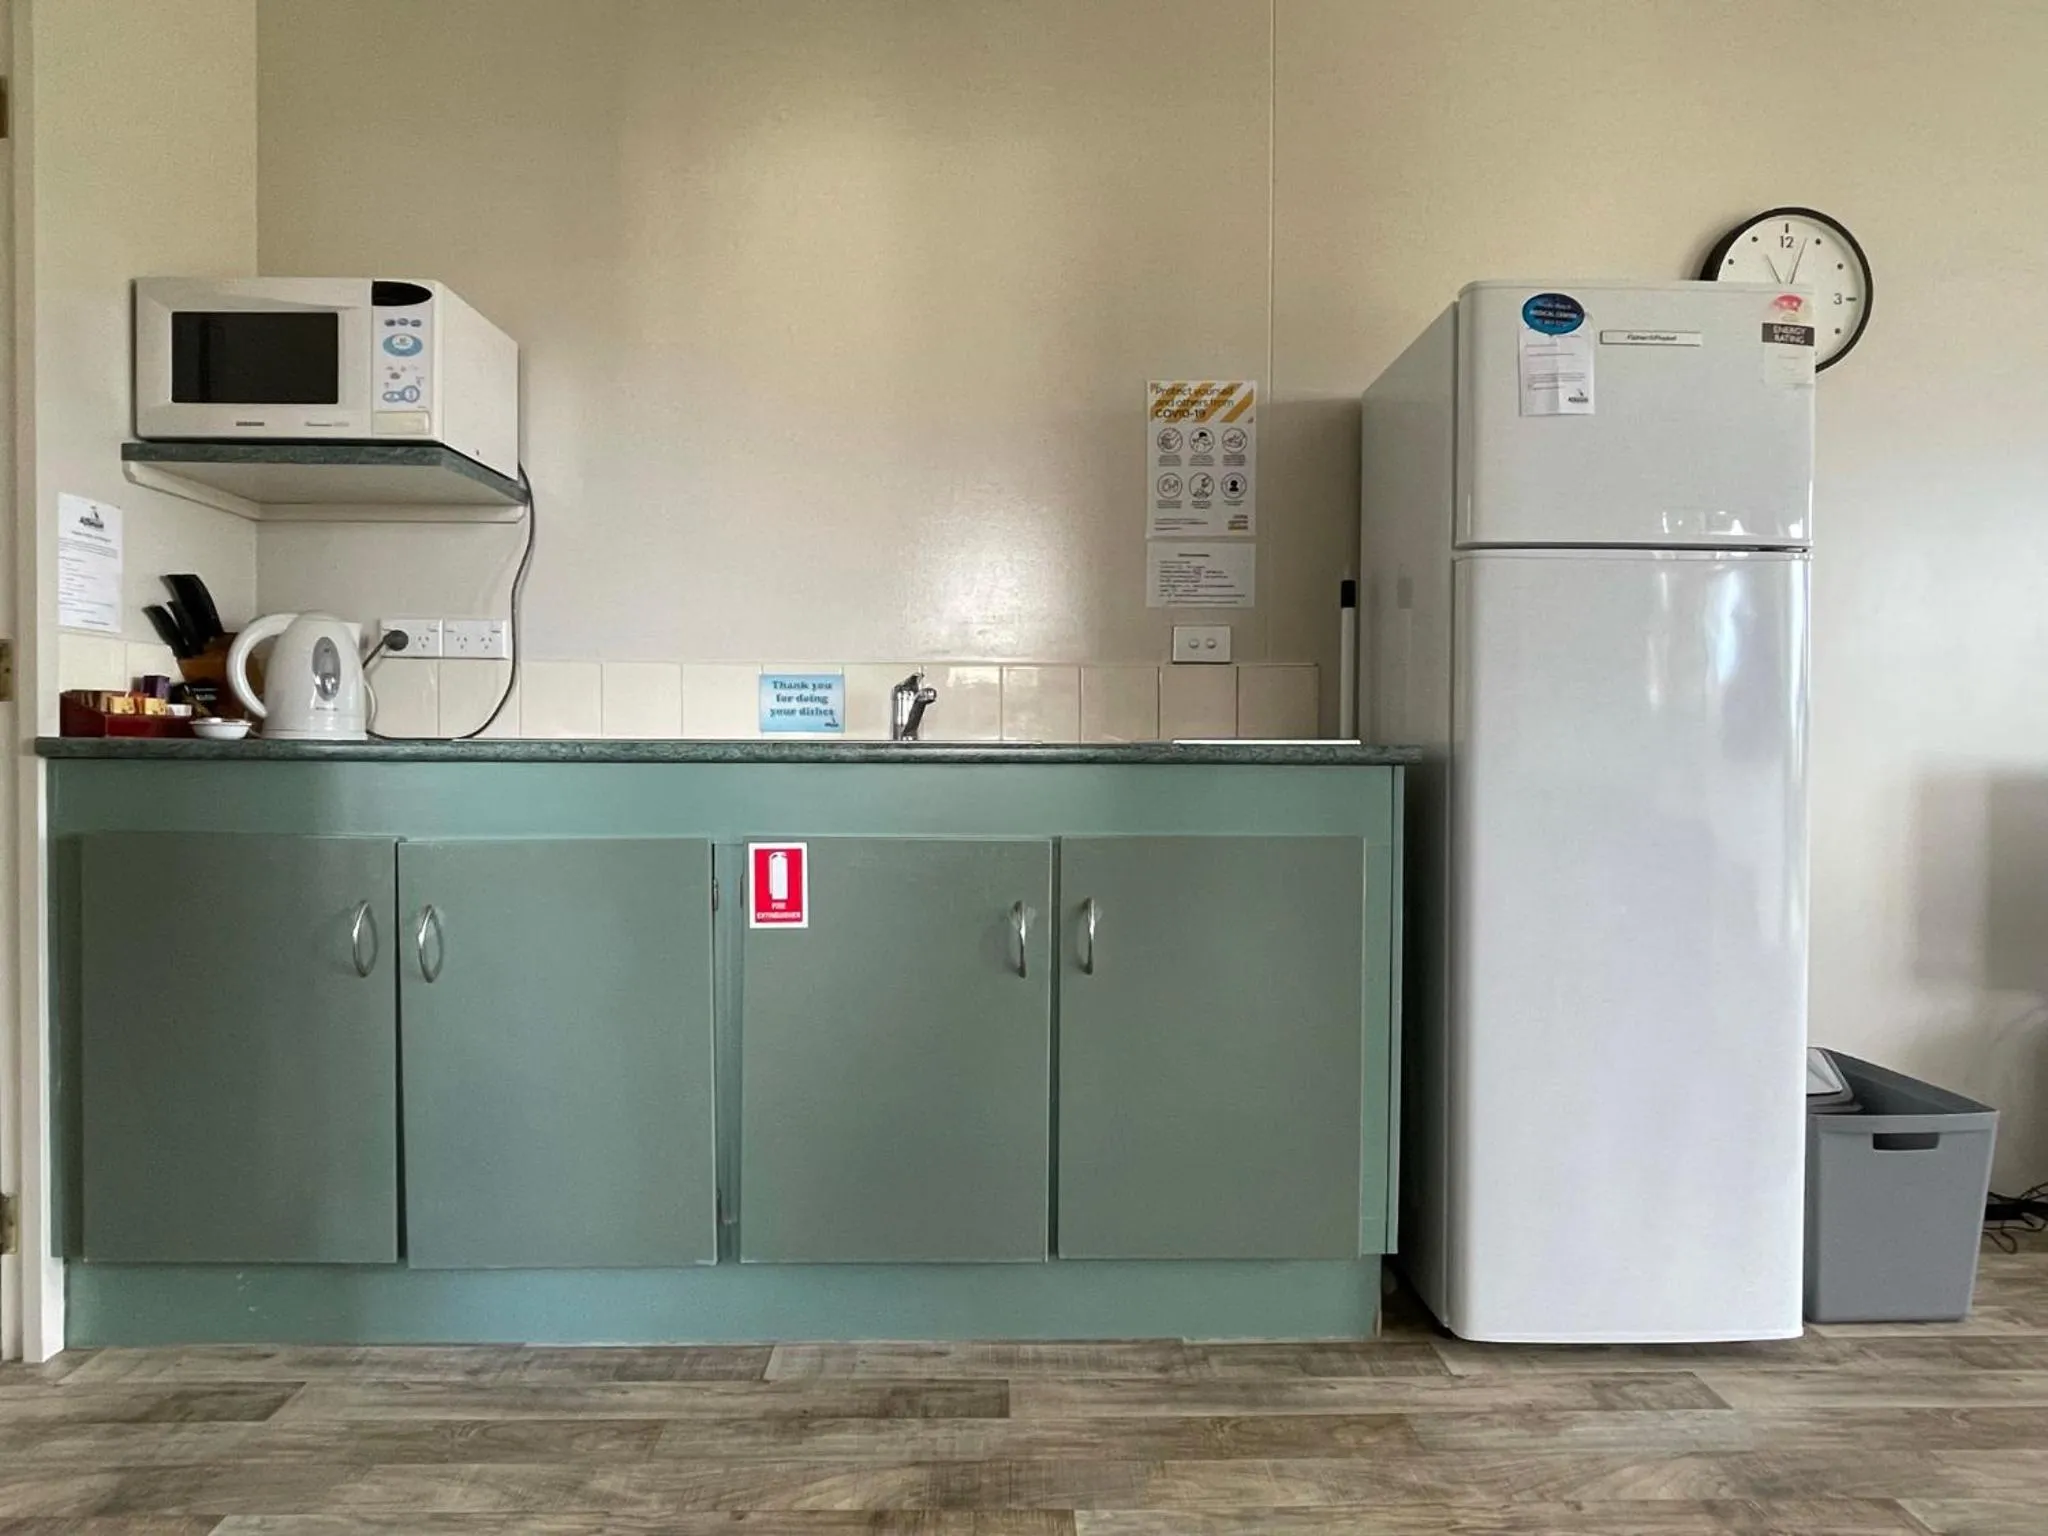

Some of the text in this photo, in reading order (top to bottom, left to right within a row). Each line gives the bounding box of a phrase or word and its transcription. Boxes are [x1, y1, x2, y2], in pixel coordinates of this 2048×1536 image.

[1779, 235, 1794, 249] 12
[1833, 292, 1843, 306] 3
[1773, 325, 1807, 336] ENERGY
[1774, 334, 1805, 344] RATING
[1155, 386, 1191, 396] Protect
[1155, 398, 1234, 408] and others from
[1155, 408, 1206, 419] COVID-19
[772, 680, 833, 691] Thank you
[776, 693, 828, 704] for doing
[769, 706, 834, 718] your dishes
